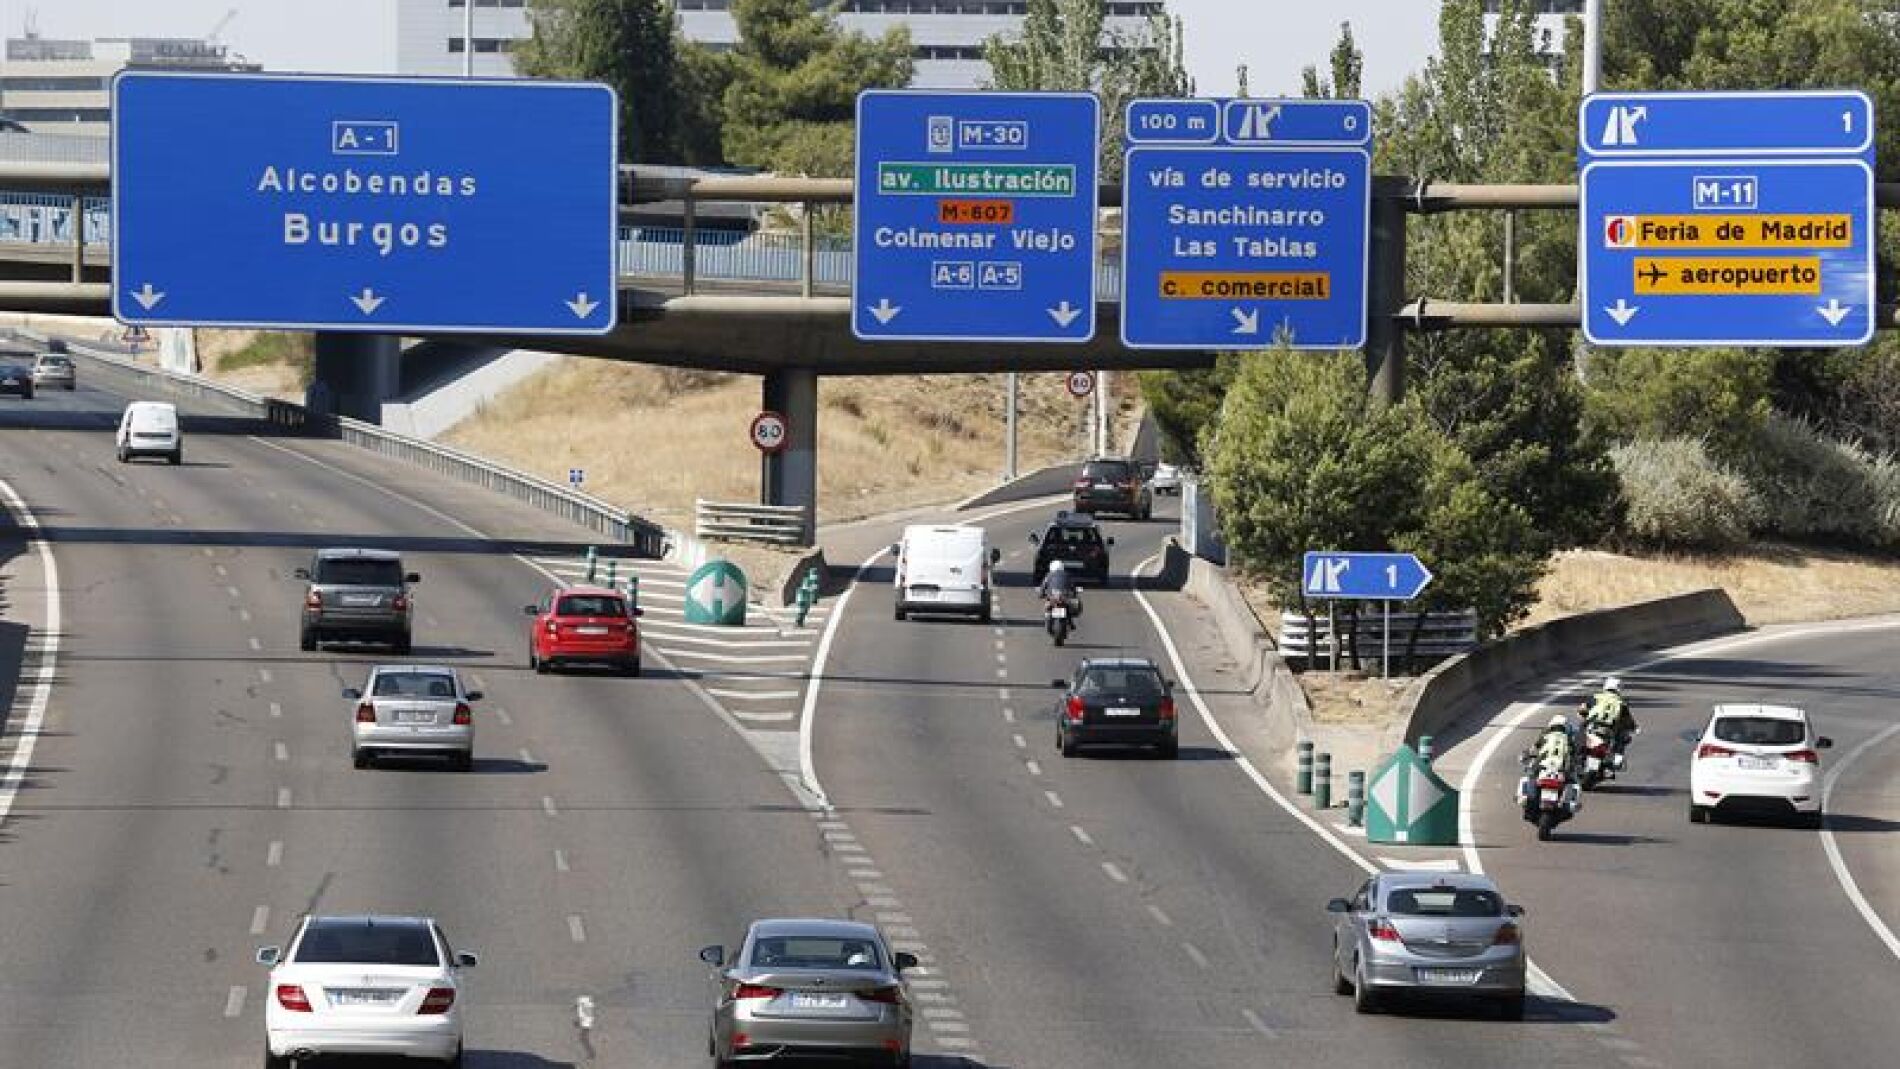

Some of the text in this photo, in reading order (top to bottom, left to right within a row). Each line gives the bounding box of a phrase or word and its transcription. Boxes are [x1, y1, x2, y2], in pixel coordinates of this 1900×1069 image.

[1139, 113, 1205, 130] 100 m
[1841, 110, 1853, 134] 1
[962, 125, 1023, 144] M-30
[257, 165, 477, 196] Alcobendas
[881, 168, 1071, 191] av. Ilustración
[1148, 165, 1347, 189] vía de servicio
[1696, 181, 1753, 204] M-11
[941, 205, 1011, 221] M-607
[1167, 203, 1325, 227] Sanchinarro
[284, 213, 448, 257] Burgos
[874, 227, 1075, 253] Colmenar Viejo
[1641, 220, 1847, 241] Feria de Madrid
[1174, 236, 1318, 258] Las Tablas
[936, 265, 971, 284] A-6
[981, 266, 1019, 285] A-5
[1680, 263, 1816, 289] aeropuerto
[1200, 278, 1325, 297] comercial
[1386, 564, 1399, 589] 1
